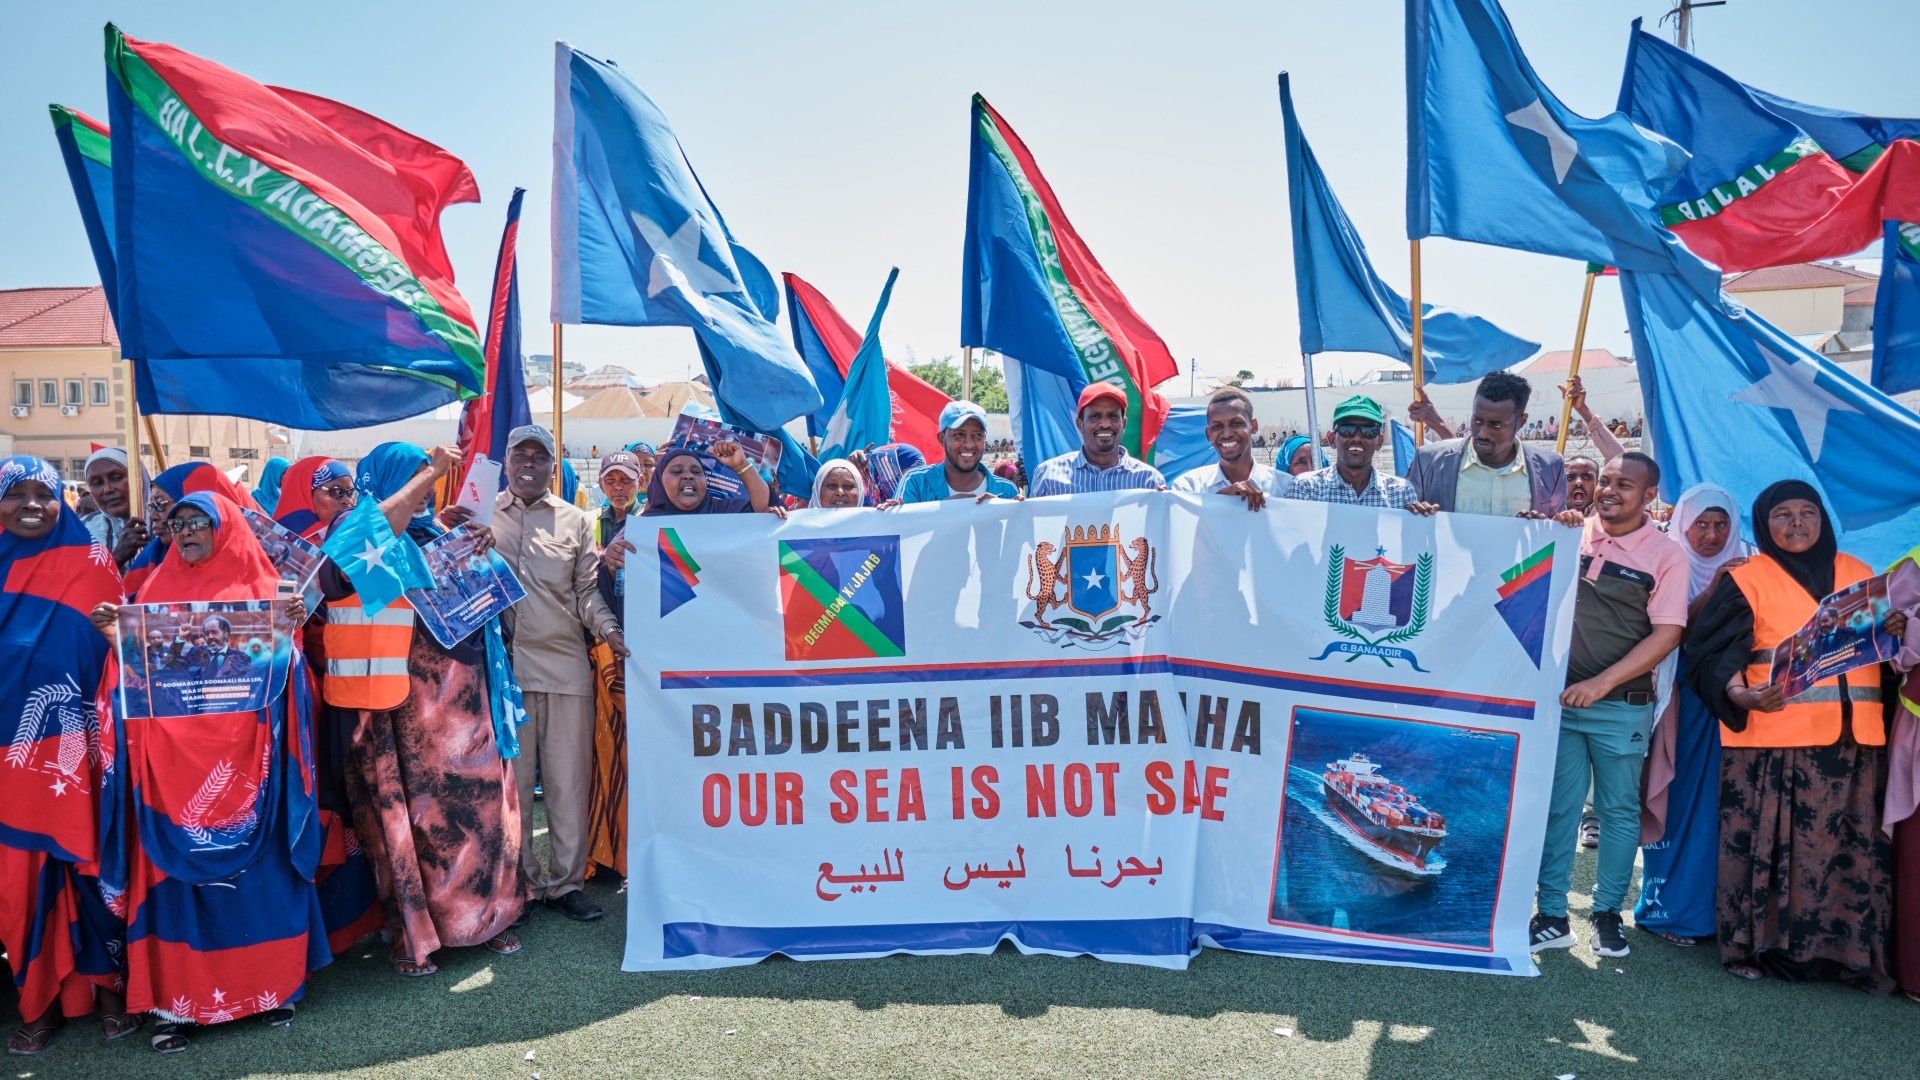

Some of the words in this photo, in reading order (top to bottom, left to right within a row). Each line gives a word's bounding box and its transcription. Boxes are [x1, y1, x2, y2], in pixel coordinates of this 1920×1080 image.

[609, 454, 629, 462] VIP
[804, 595, 848, 646] DEGMADA
[842, 553, 881, 598] X/JAJAB
[1340, 643, 1402, 658] G.BANAADIR
[692, 697, 966, 757] BADDEENA
[990, 694, 1060, 748] IIB
[1085, 690, 1261, 755] MAHA
[702, 771, 804, 828] OUR
[830, 767, 926, 824] SEA
[951, 765, 1000, 819] IS
[1025, 762, 1120, 818] NOT
[815, 847, 904, 902] للبيع
[943, 844, 1026, 890] ليس
[1065, 843, 1163, 888] بحرنا
